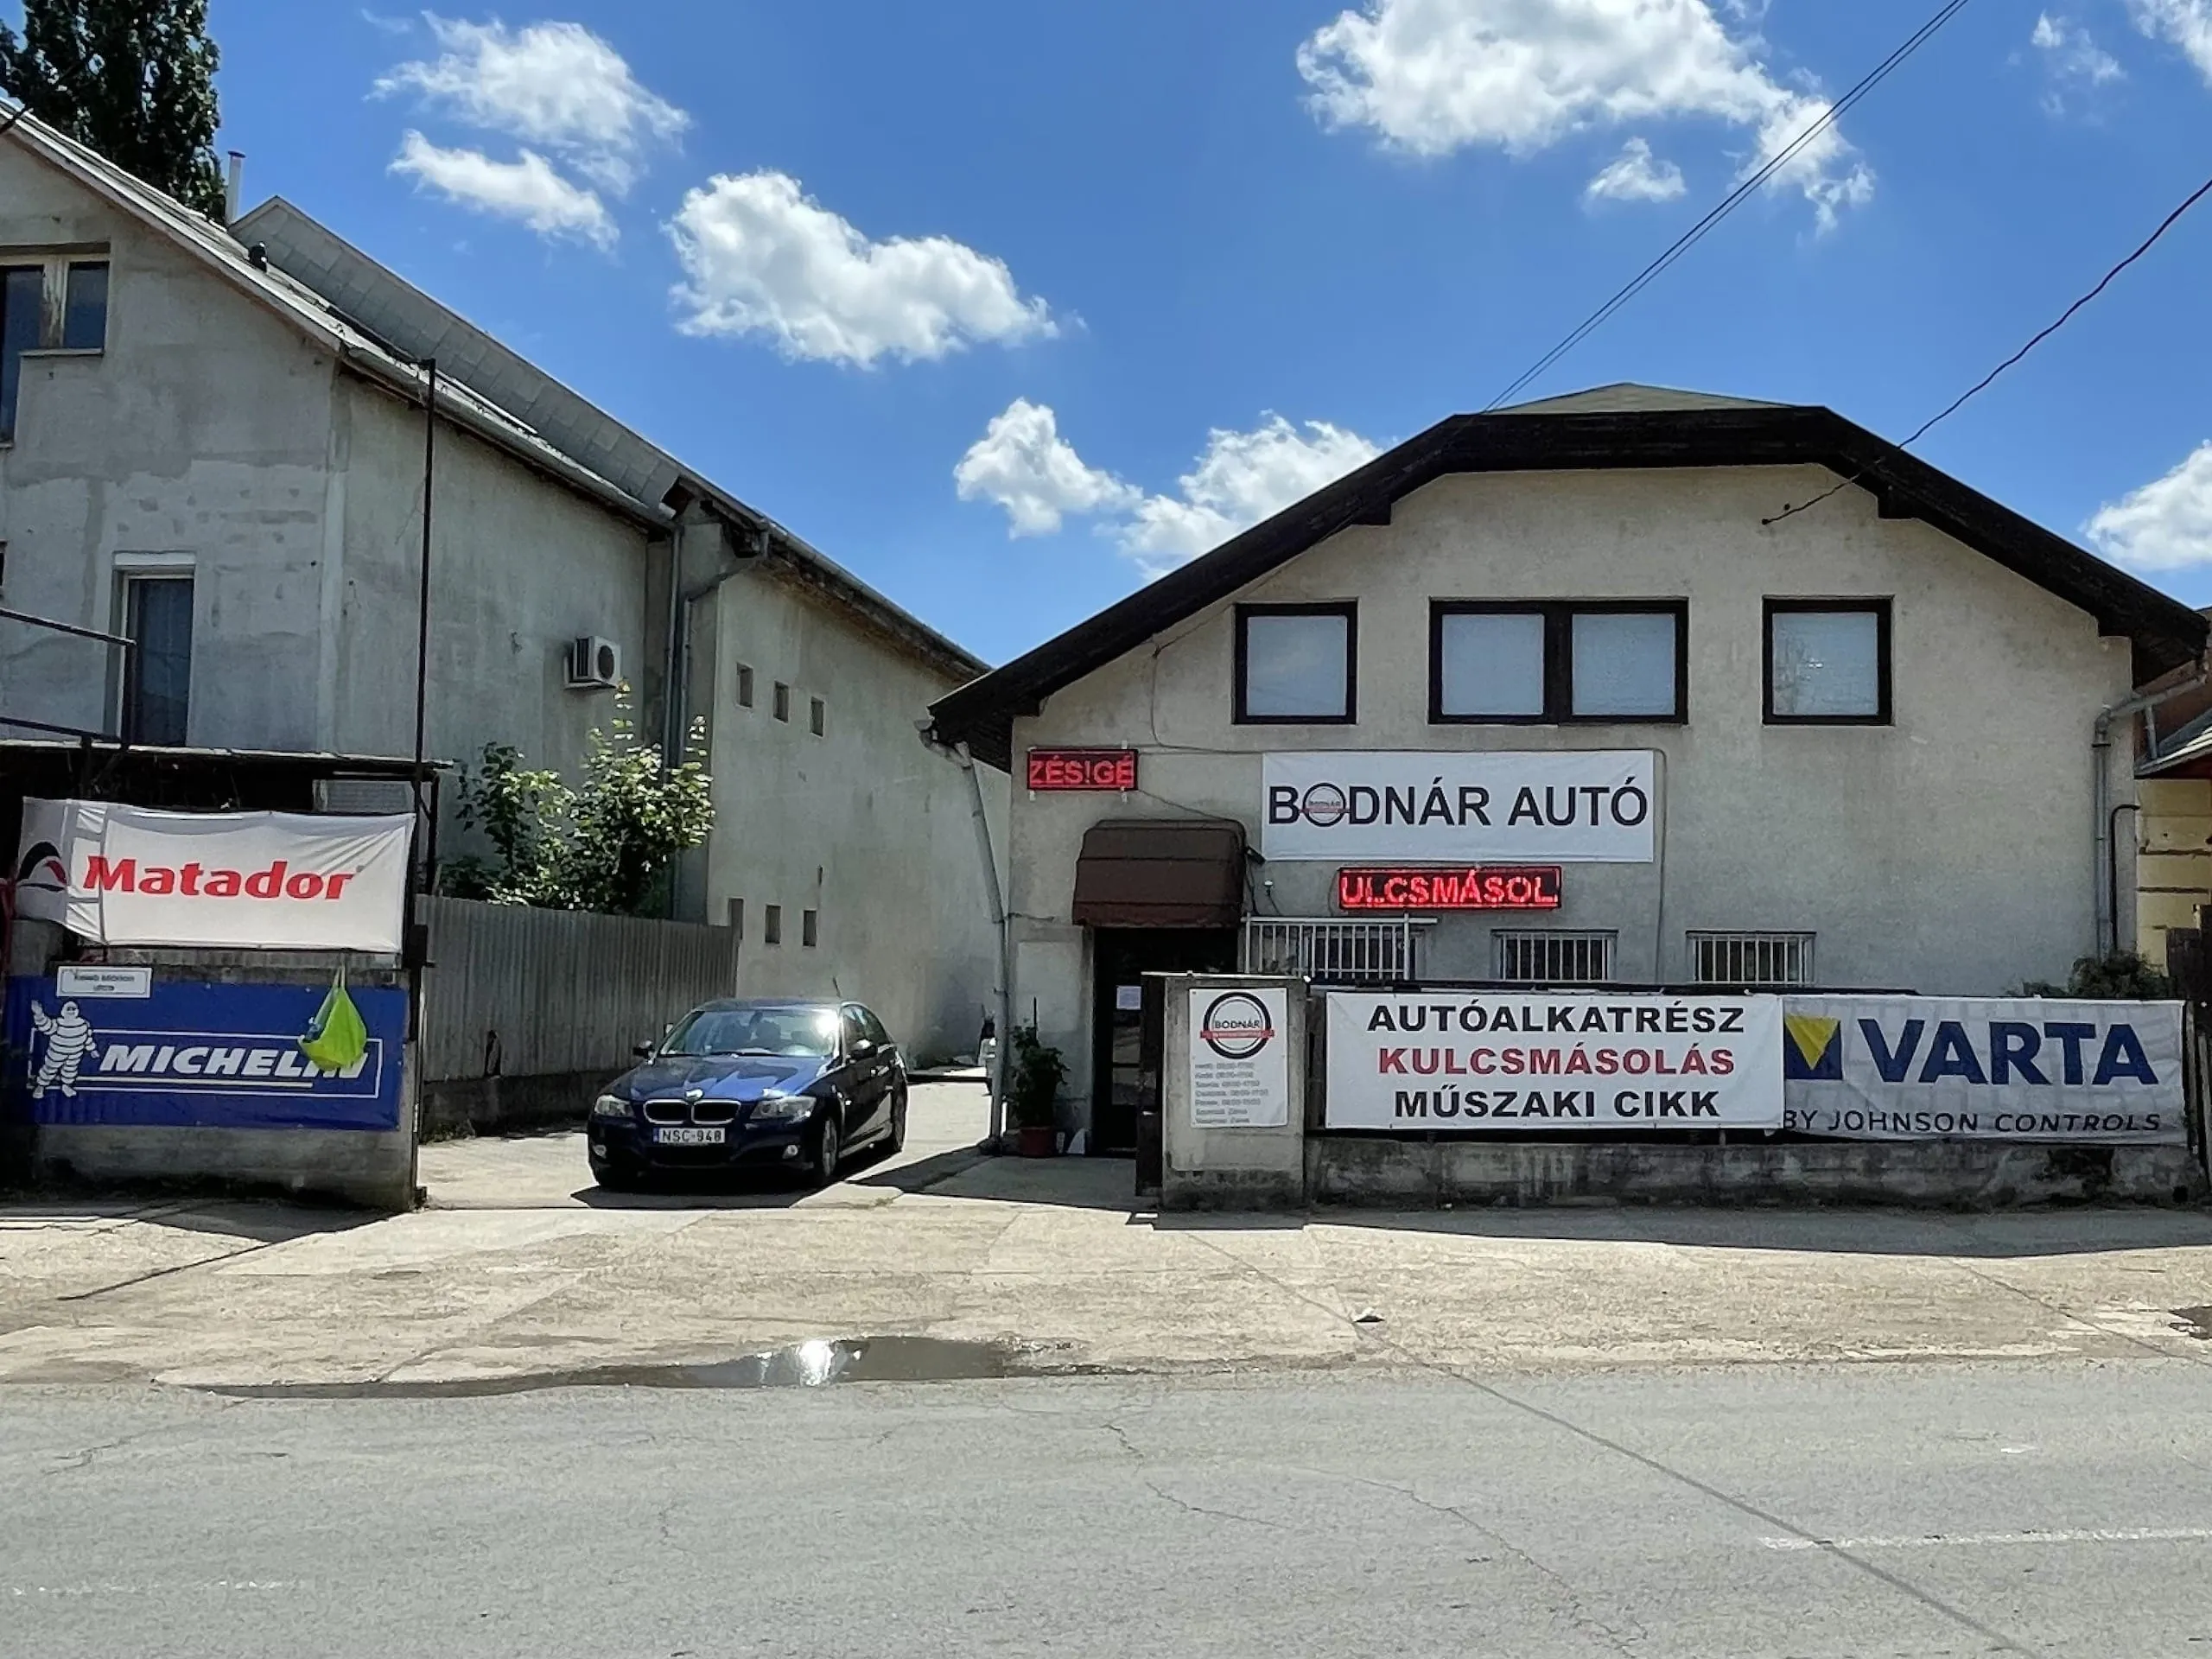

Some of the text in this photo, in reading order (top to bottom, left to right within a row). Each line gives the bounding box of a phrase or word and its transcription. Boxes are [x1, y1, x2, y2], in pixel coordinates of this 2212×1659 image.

[1268, 778, 1648, 827] BODNÁR AUTÓ
[83, 856, 353, 899] Matador
[1215, 1018, 1261, 1029] BODNÁR
[1368, 1000, 1745, 1033] AUTÓALKATRÉSZ
[1379, 1042, 1735, 1076] KULCSMÁSOLÁS
[1858, 1018, 2158, 1085] VARTA
[1395, 1084, 1719, 1118] MŰSZAKI CIKK
[1783, 1109, 2160, 1132] BY JOHNSON CONTROLS
